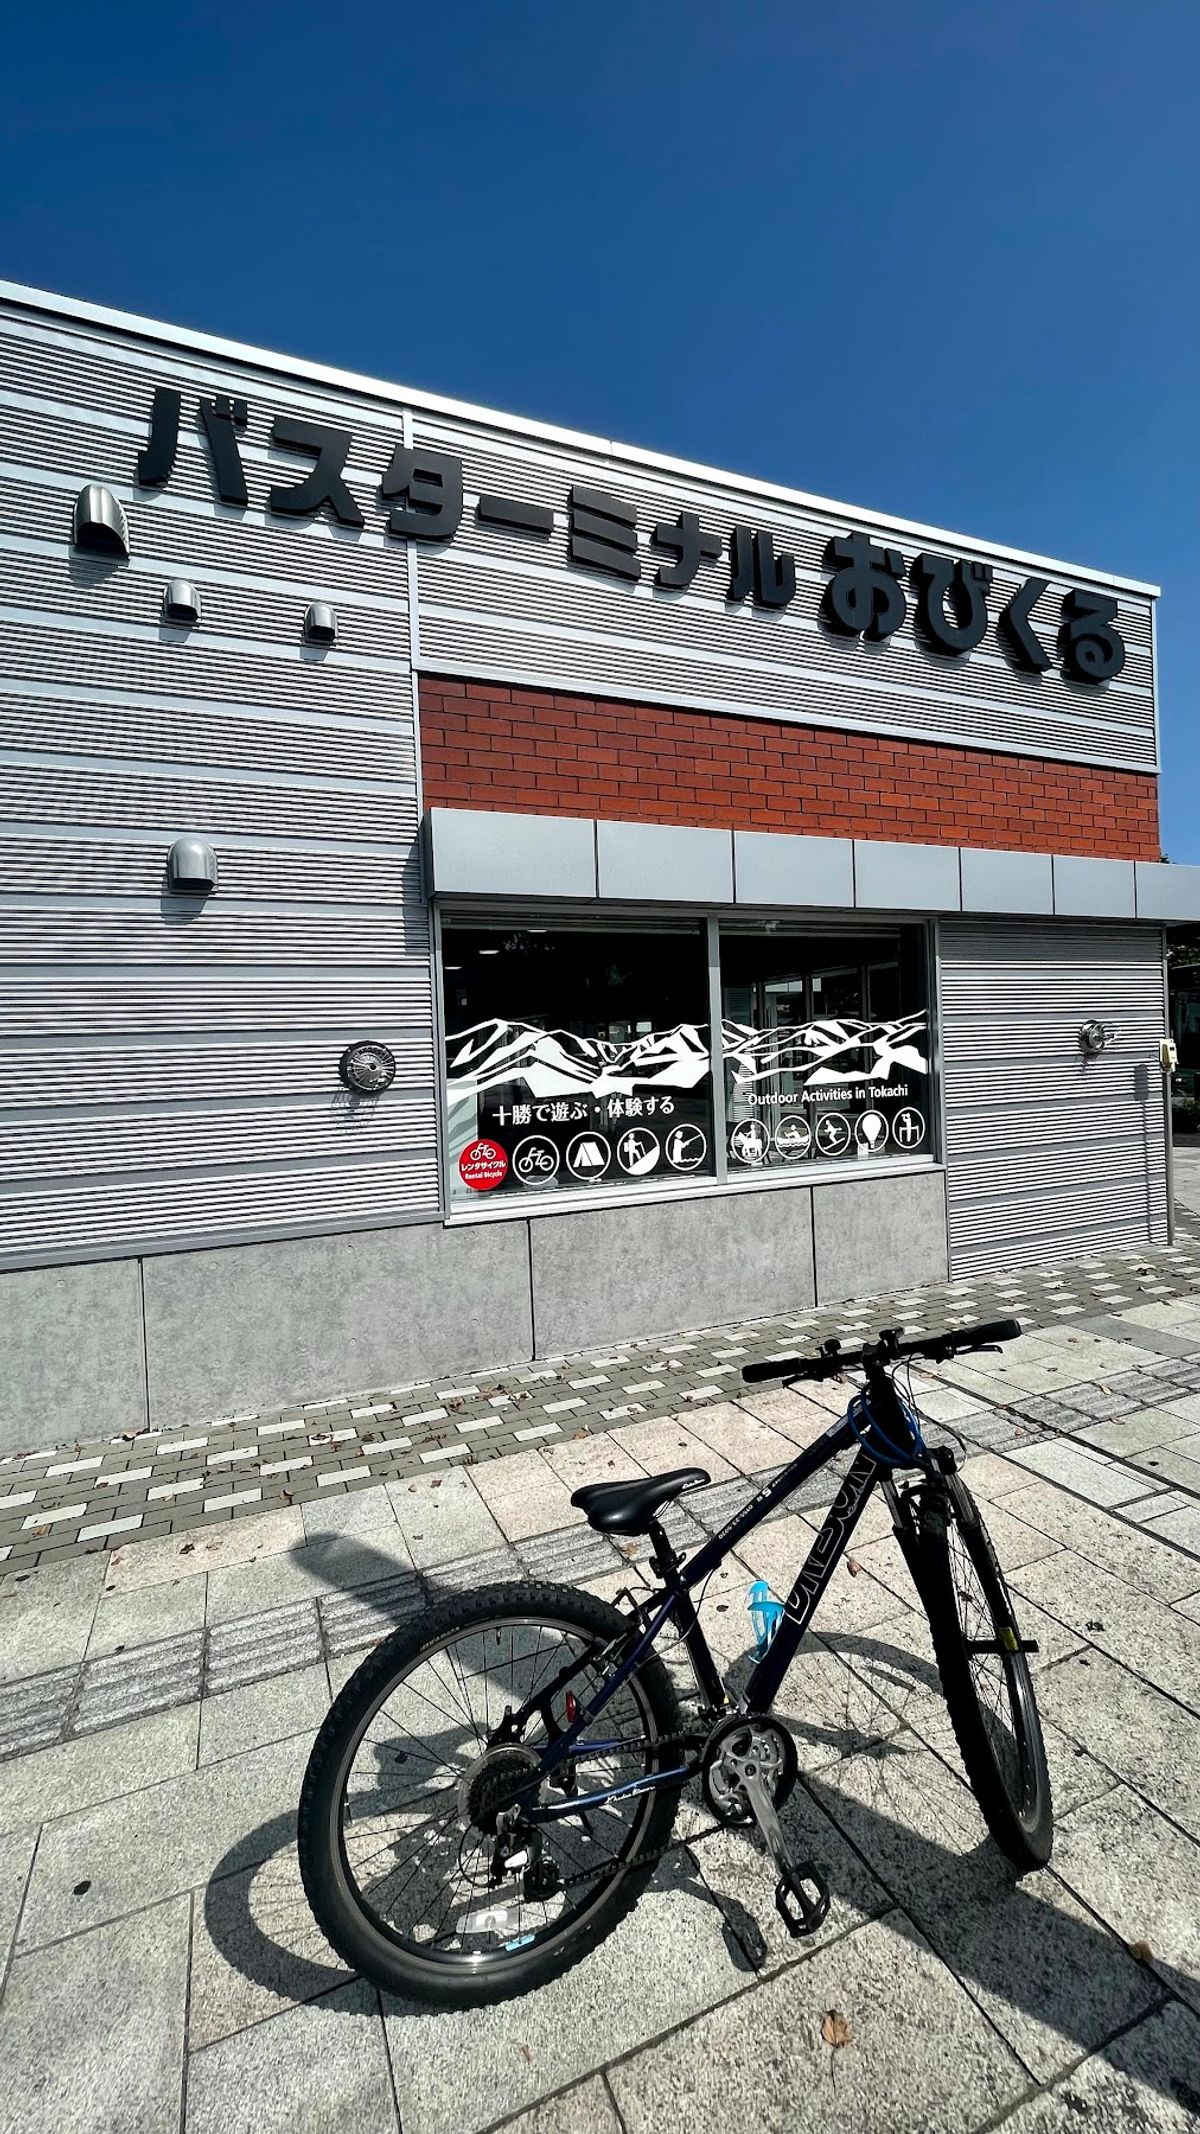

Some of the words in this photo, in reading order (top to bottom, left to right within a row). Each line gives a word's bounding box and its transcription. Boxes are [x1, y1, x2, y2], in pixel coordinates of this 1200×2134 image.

[138, 385, 796, 609] バスターミナル
[824, 530, 1126, 686] おびくる
[748, 1091, 798, 1105] Outdoor
[801, 1087, 853, 1103] Activities
[855, 1086, 866, 1099] in
[869, 1084, 908, 1098] Tokachi
[492, 1096, 675, 1126] 十勝で遊ぶ・体験する
[461, 1160, 506, 1171] レンタサイクル
[465, 1172, 483, 1180] Rental
[484, 1170, 503, 1179] Bicycle
